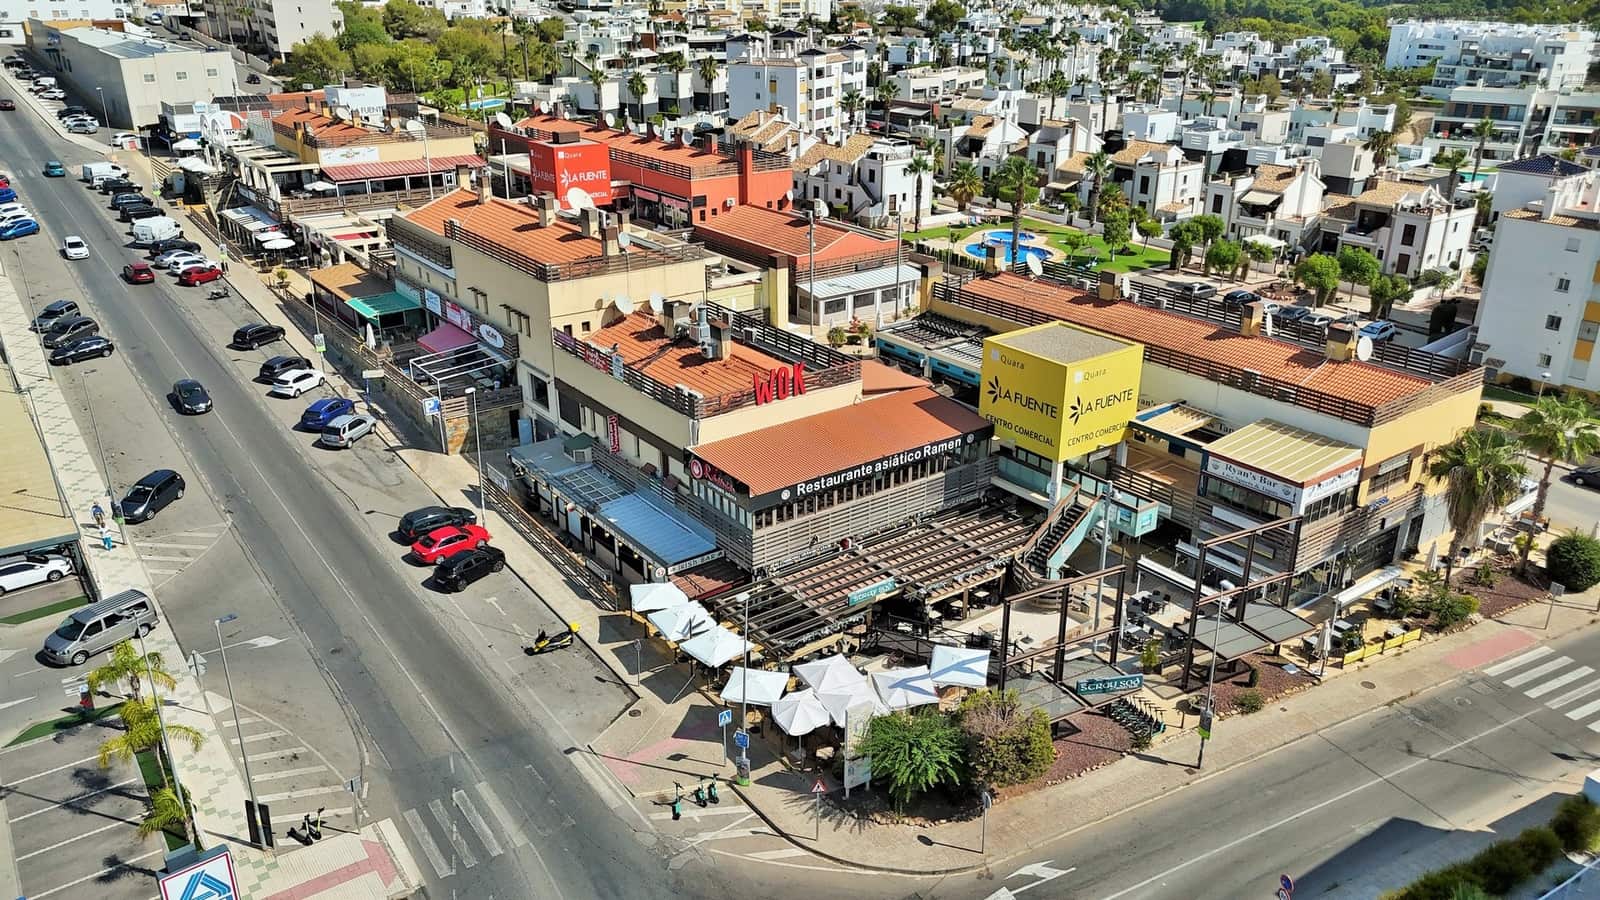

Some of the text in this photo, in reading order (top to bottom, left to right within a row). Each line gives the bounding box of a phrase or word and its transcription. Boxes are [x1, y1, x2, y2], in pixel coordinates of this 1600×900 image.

[568, 169, 608, 183] LA FUENTE
[1000, 354, 1025, 370] Quara
[1083, 368, 1107, 382] Quara
[753, 360, 807, 406] WOK
[999, 385, 1058, 420] LA FUENTE
[1079, 387, 1134, 416] LA FUENTE
[985, 413, 1056, 448] CENTRO COMERCIAL
[1067, 420, 1130, 448] CENTRO COMERCIAL
[796, 438, 962, 497] Restaurante asiático Ramen
[1224, 463, 1279, 489] Ryan's Bar
